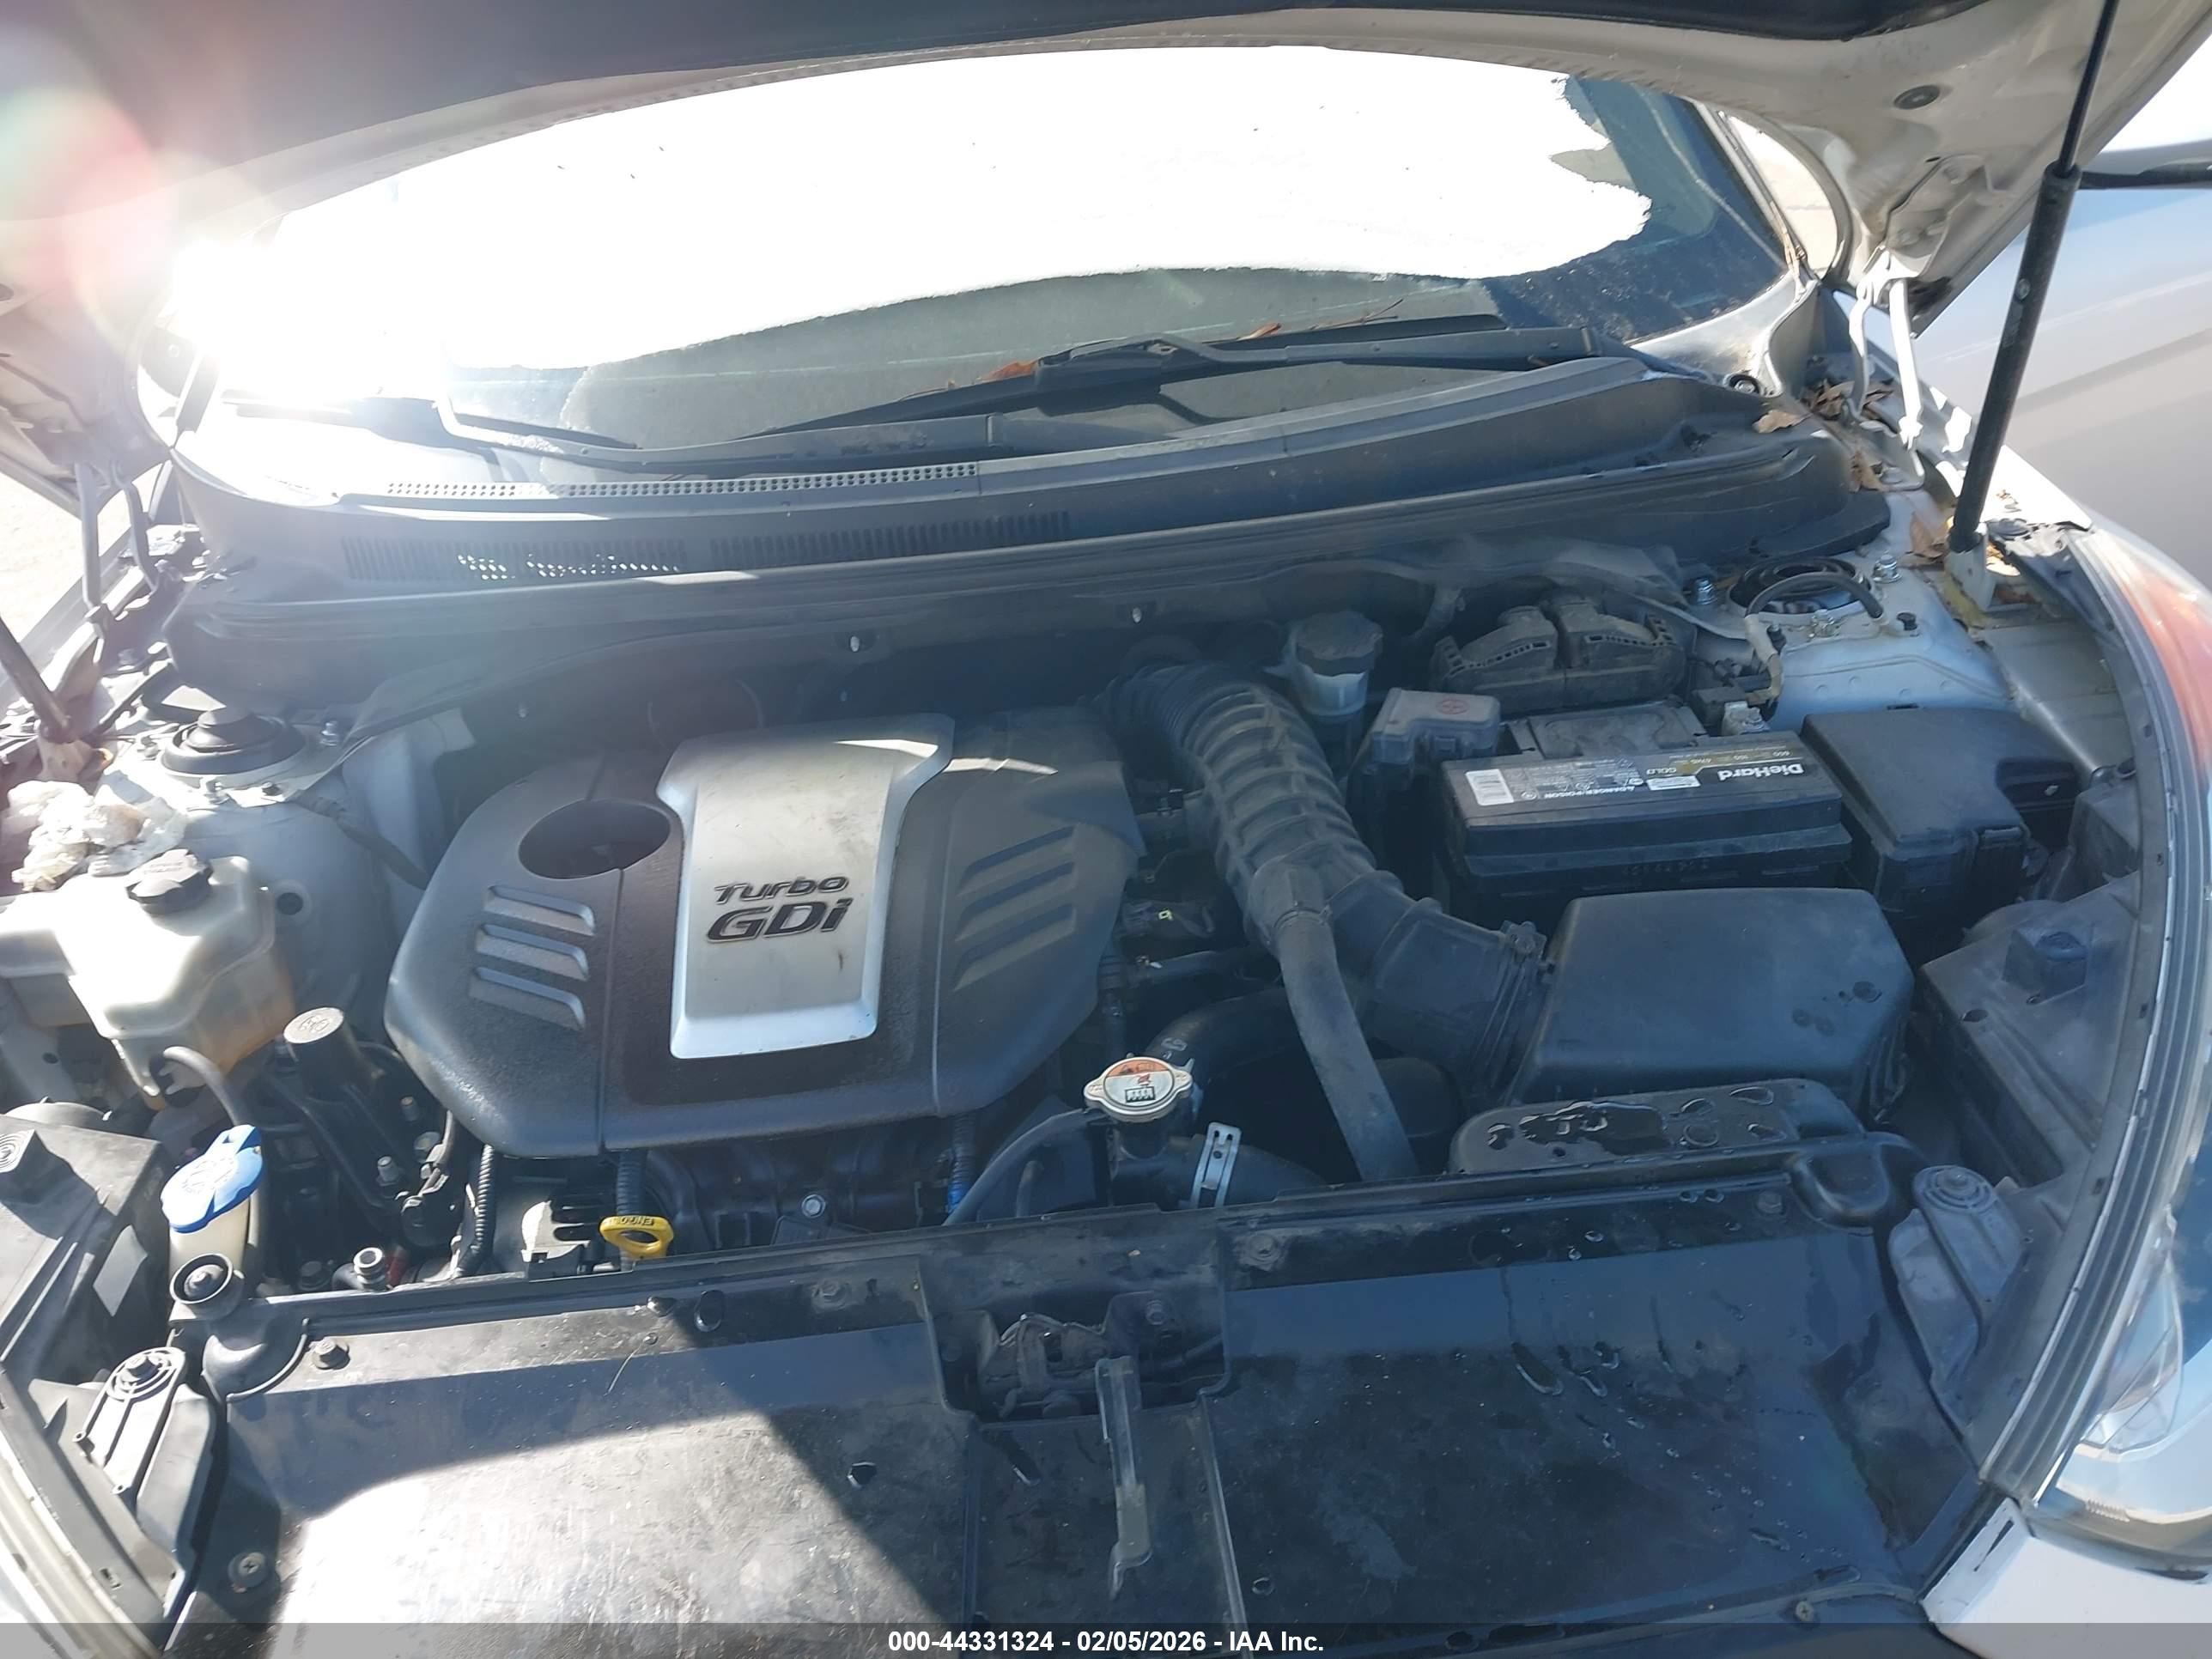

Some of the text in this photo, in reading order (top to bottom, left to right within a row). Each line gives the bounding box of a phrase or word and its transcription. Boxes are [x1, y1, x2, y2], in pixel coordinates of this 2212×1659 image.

[1646, 766, 1677, 775] GOLD
[1717, 763, 1804, 781] DieHard
[714, 876, 849, 905] Turbo
[707, 897, 854, 943] GDi
